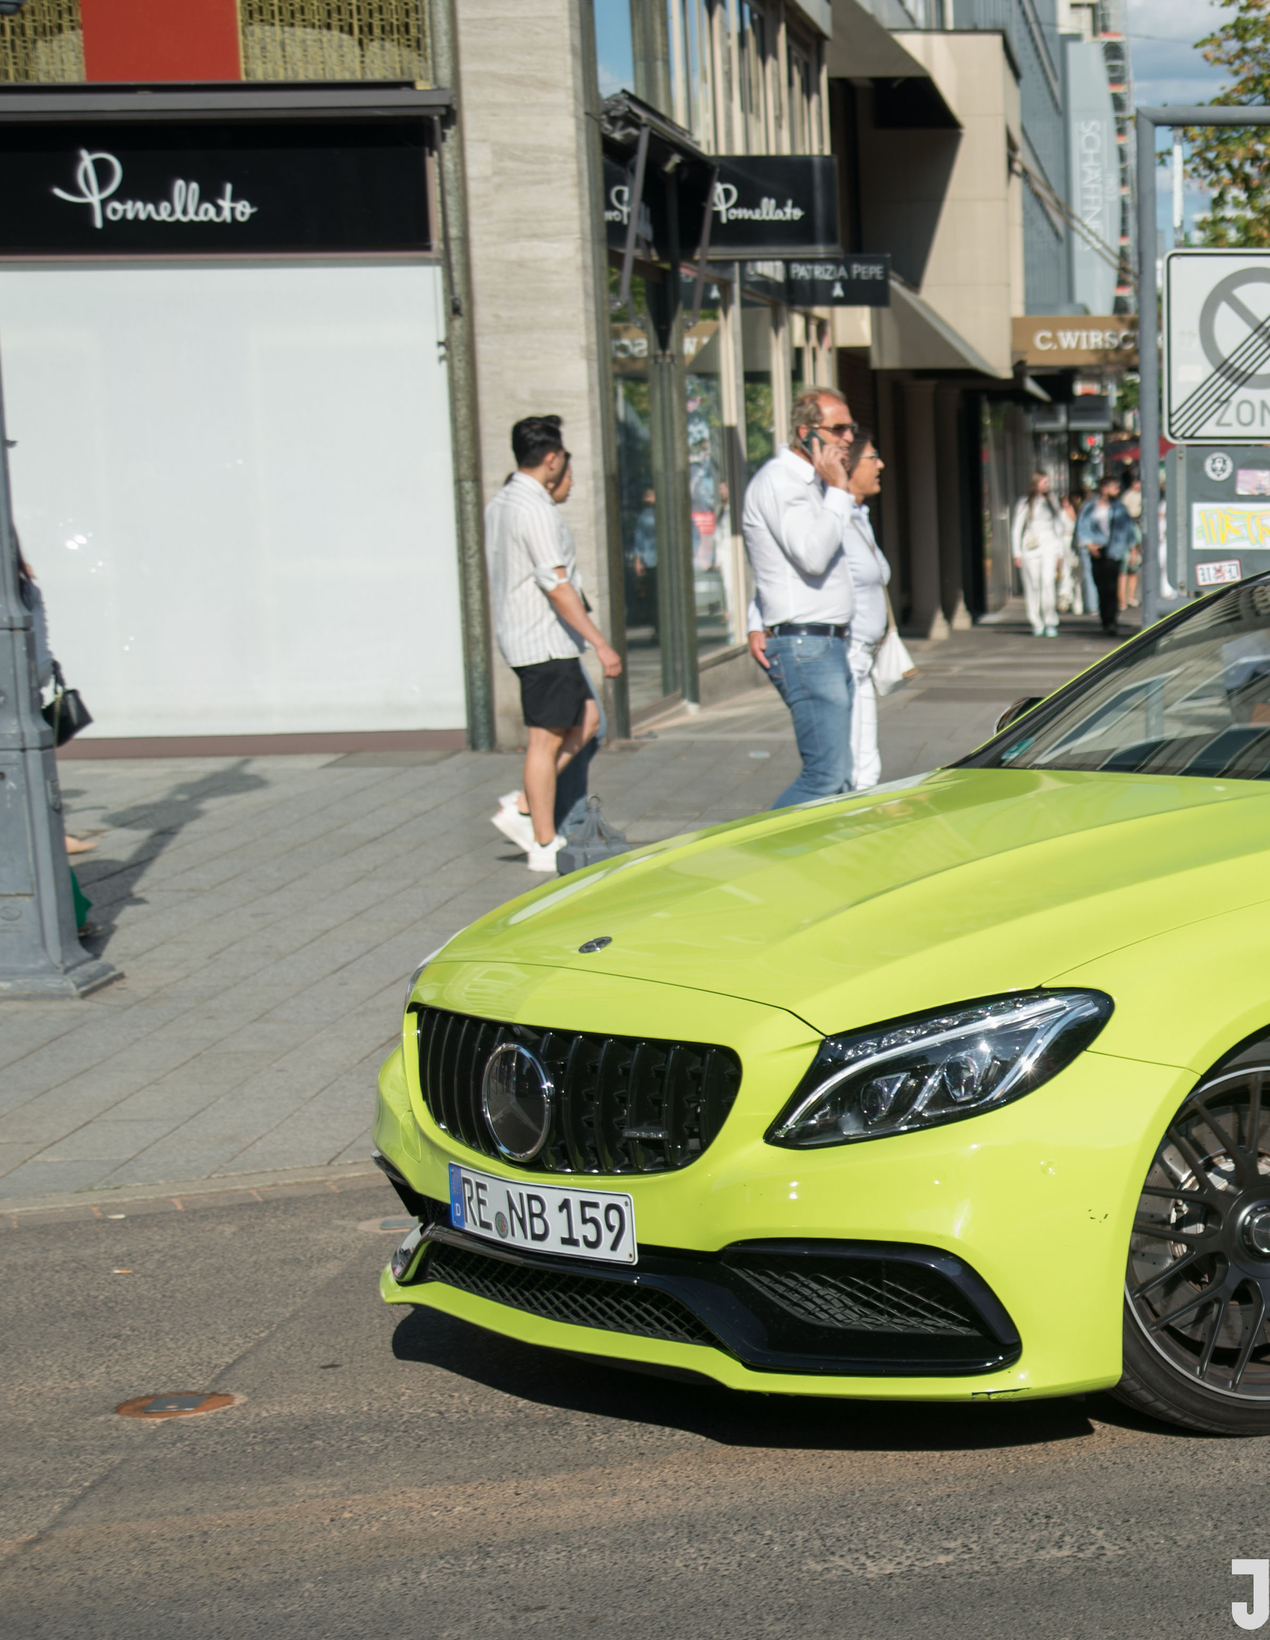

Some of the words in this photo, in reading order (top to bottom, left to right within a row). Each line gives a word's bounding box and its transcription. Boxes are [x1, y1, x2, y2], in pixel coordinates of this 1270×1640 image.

[52, 148, 258, 228] Pomellato
[703, 181, 805, 224] Pomellato
[790, 262, 848, 280] PATRIZIA
[852, 262, 885, 280] PEPE
[1034, 327, 1139, 351] C.WIRSC
[455, 1203, 462, 1217] D
[462, 1177, 493, 1231] RE
[507, 1189, 549, 1242] NB
[559, 1198, 626, 1251] 159
